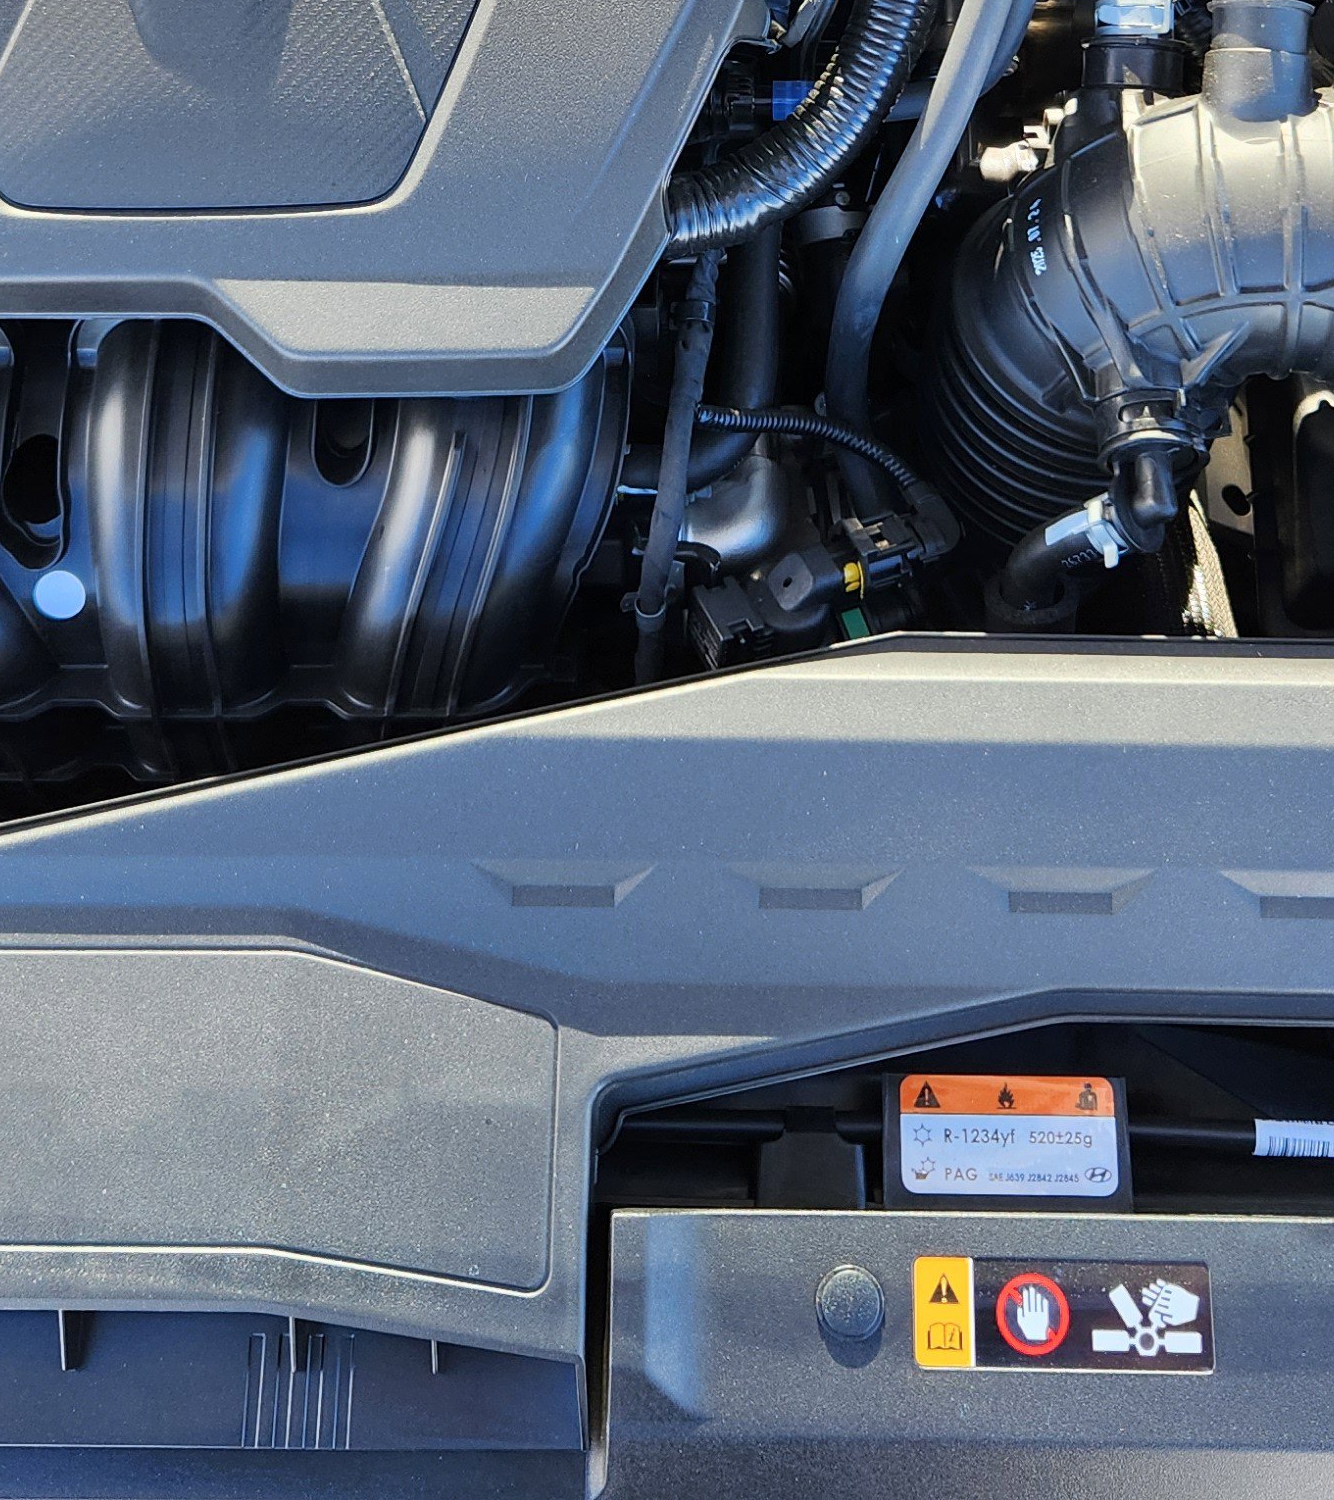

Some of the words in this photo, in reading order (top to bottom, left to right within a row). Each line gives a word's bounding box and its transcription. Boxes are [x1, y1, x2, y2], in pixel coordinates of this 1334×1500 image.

[943, 1127, 1016, 1148] R-1234yf
[1028, 1130, 1093, 1148] 520±25g
[945, 1167, 978, 1181] PAG
